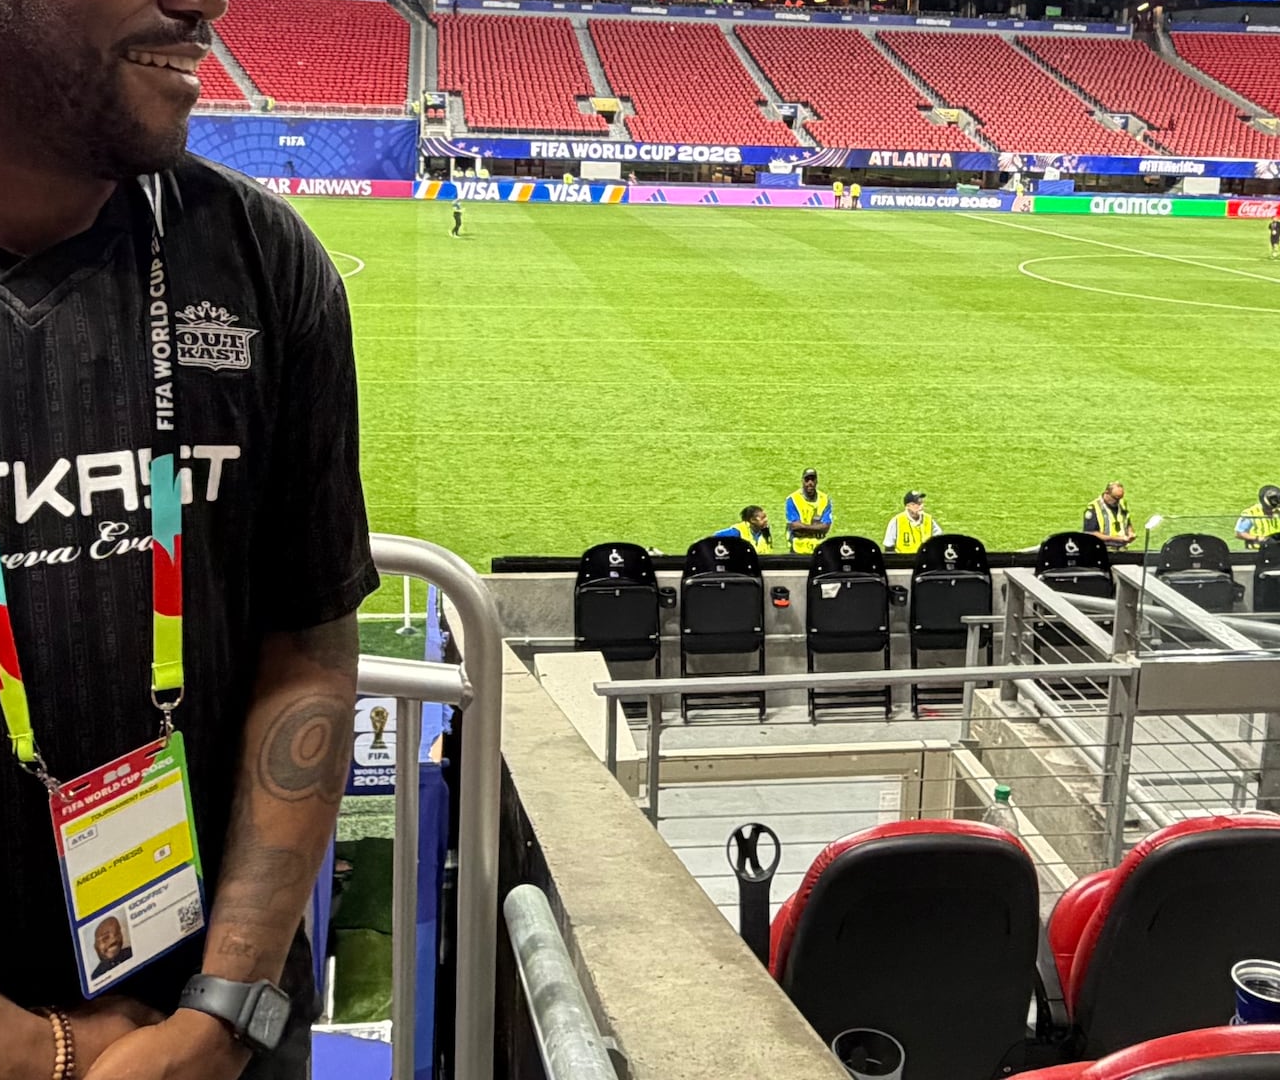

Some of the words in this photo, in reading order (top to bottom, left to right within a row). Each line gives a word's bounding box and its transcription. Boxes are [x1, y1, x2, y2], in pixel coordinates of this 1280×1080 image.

[278, 135, 307, 147] FIFA
[529, 141, 570, 158] FIFA
[571, 143, 639, 160] WORLD
[639, 145, 676, 161] CUP
[677, 146, 743, 162] 2026
[868, 151, 953, 168] ATLANTA
[296, 178, 372, 196] AIRWAYS
[454, 181, 501, 200] VISA
[547, 183, 592, 202] VISA
[870, 194, 895, 206] FIFA
[896, 195, 937, 208] WORLD
[937, 196, 959, 208] CUP
[1090, 197, 1173, 216] aramco
[149, 258, 166, 298] CUP
[150, 300, 172, 380] WORLD
[176, 331, 244, 348] OUT
[178, 346, 246, 364] KAST
[155, 381, 175, 431] FIFA
[367, 752, 390, 761] FIFA
[353, 768, 385, 776] WORLD
[61, 800, 86, 817] FIFA
[84, 782, 121, 805] WORLD
[119, 772, 141, 788] CUP
[140, 756, 175, 777] 2026
[76, 866, 107, 887] MEDIA
[113, 846, 144, 867] PRESS
